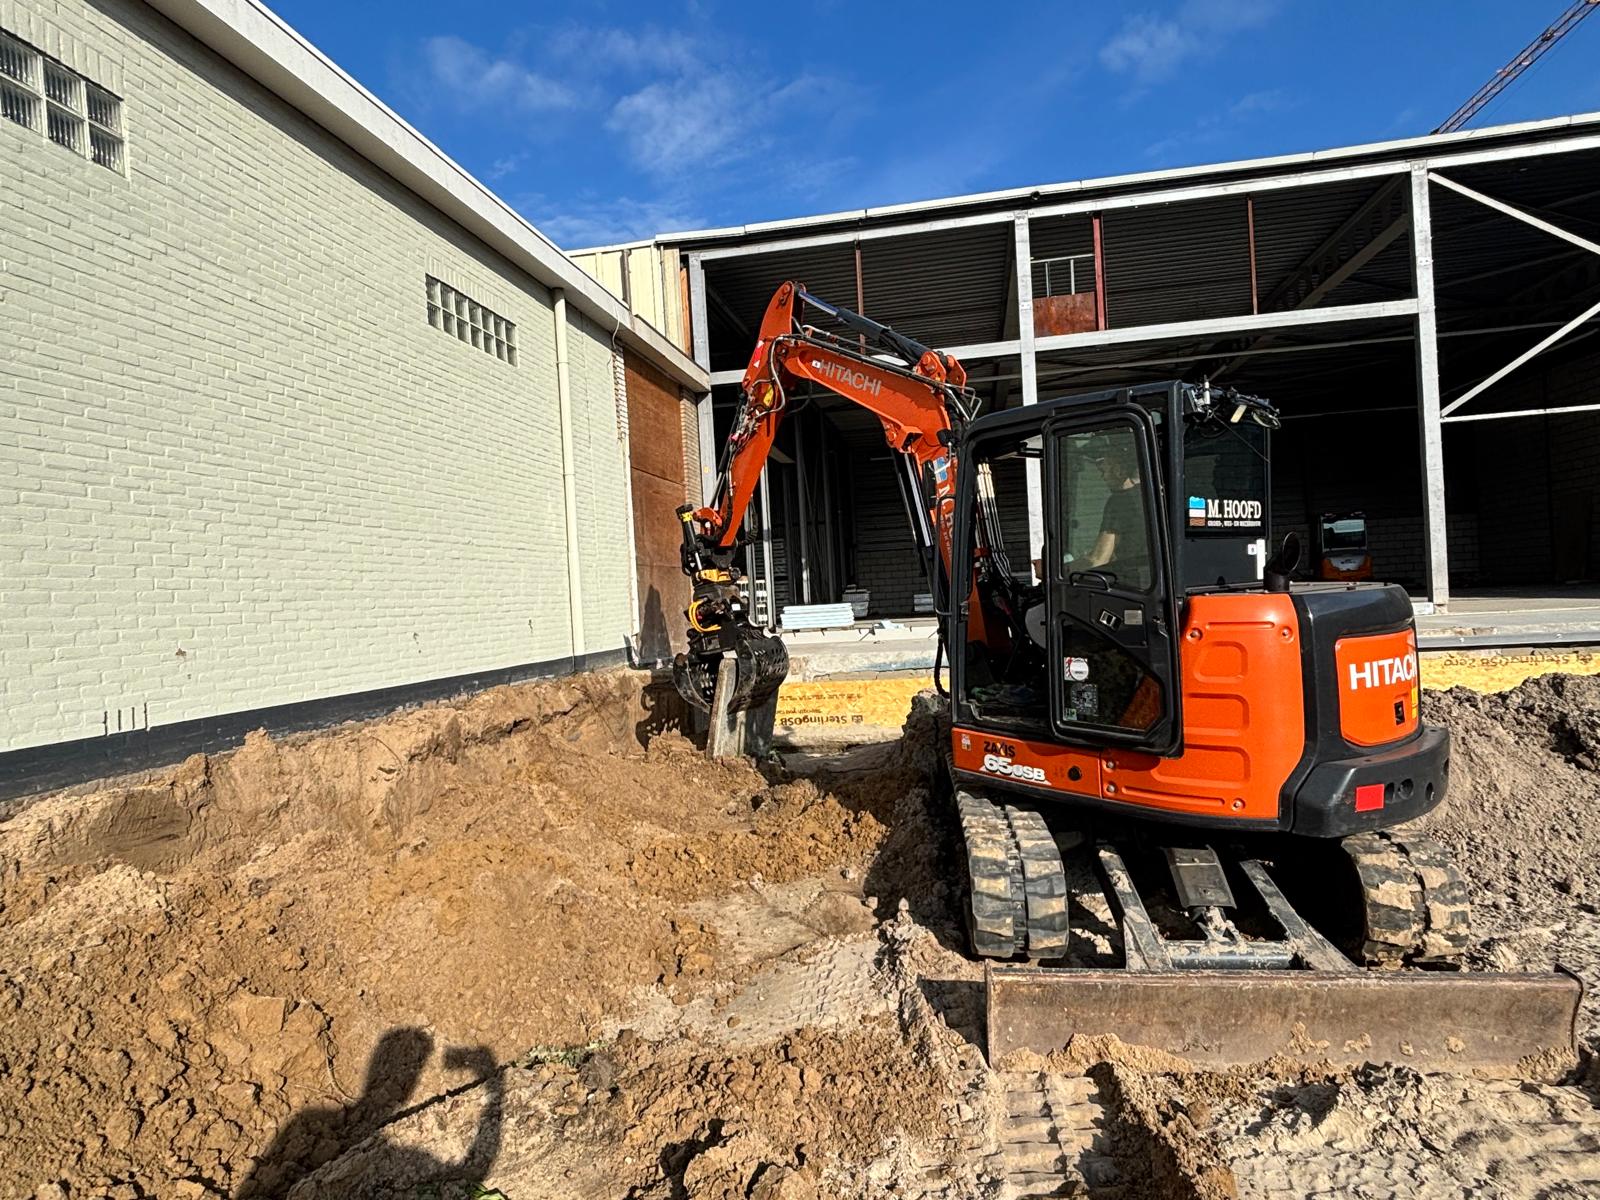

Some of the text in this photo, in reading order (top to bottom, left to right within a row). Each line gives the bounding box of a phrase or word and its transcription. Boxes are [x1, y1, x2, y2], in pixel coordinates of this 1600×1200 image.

[819, 359, 882, 397] HITACHI
[1207, 499, 1262, 519] M. HOOFD
[780, 714, 847, 726] SterlingOSB
